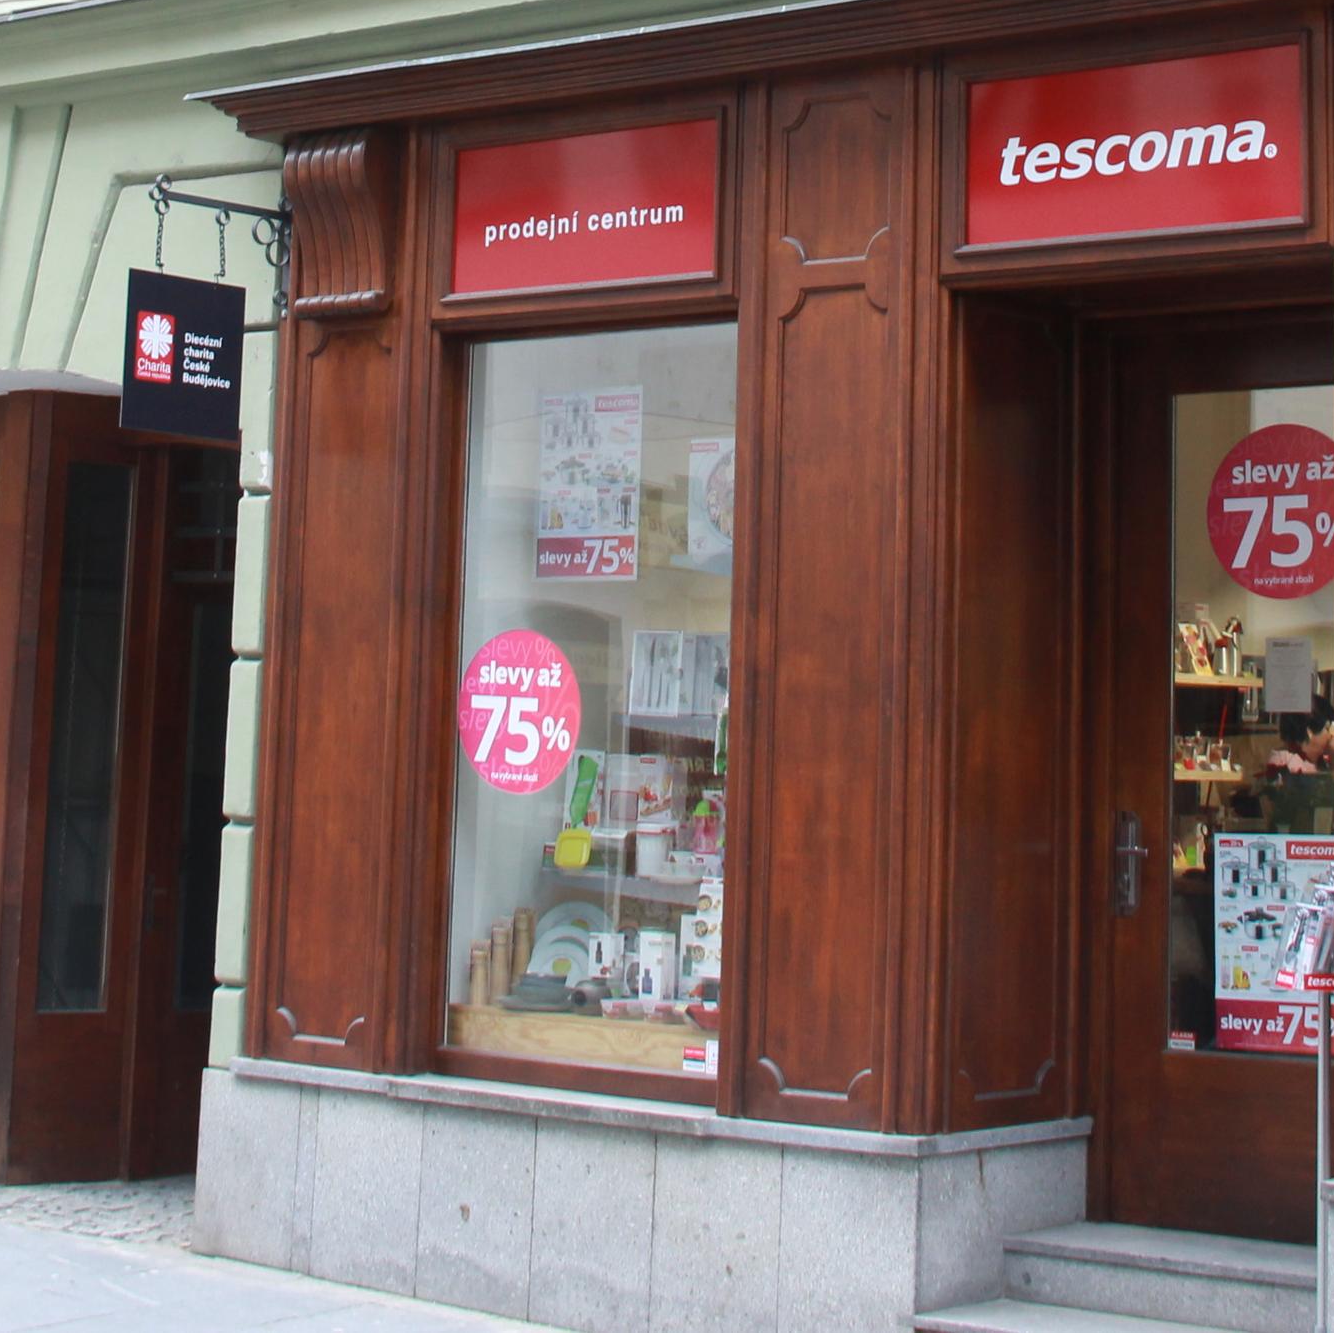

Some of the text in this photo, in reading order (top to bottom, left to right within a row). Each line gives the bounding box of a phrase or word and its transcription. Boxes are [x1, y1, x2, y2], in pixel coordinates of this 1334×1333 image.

[484, 204, 684, 247] prodejní centrum
[184, 331, 224, 349] Diecézní
[183, 345, 215, 360] charita
[137, 357, 172, 374] Charita
[183, 357, 211, 373] České
[182, 372, 231, 389] Budějovice
[1231, 459, 1300, 489] slevy
[539, 539, 635, 574] slevy až 75%
[478, 659, 563, 693] slevy až
[470, 693, 571, 766] 75%
[1220, 1014, 1263, 1036] slevy
[1265, 1015, 1285, 1033] až
